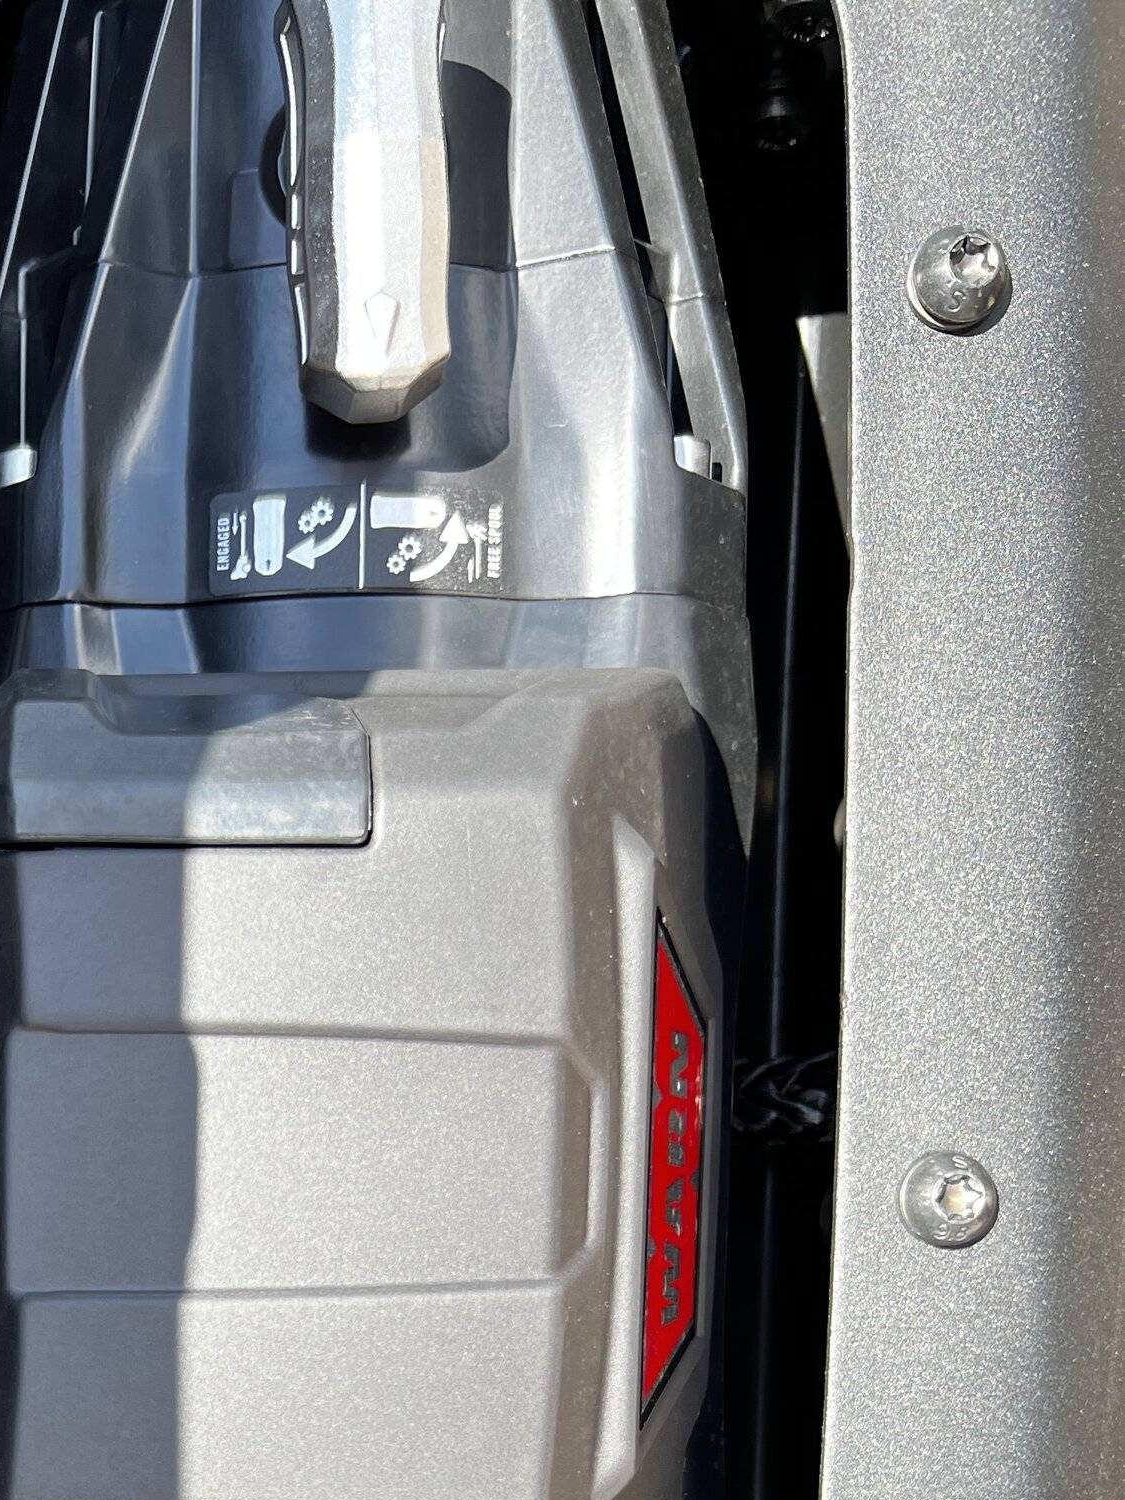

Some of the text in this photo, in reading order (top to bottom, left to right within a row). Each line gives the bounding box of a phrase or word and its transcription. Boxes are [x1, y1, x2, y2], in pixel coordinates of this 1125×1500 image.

[217, 516, 230, 571] ENGAGED
[487, 504, 503, 578] FREE SPOOL
[661, 1031, 689, 1327] WARN
